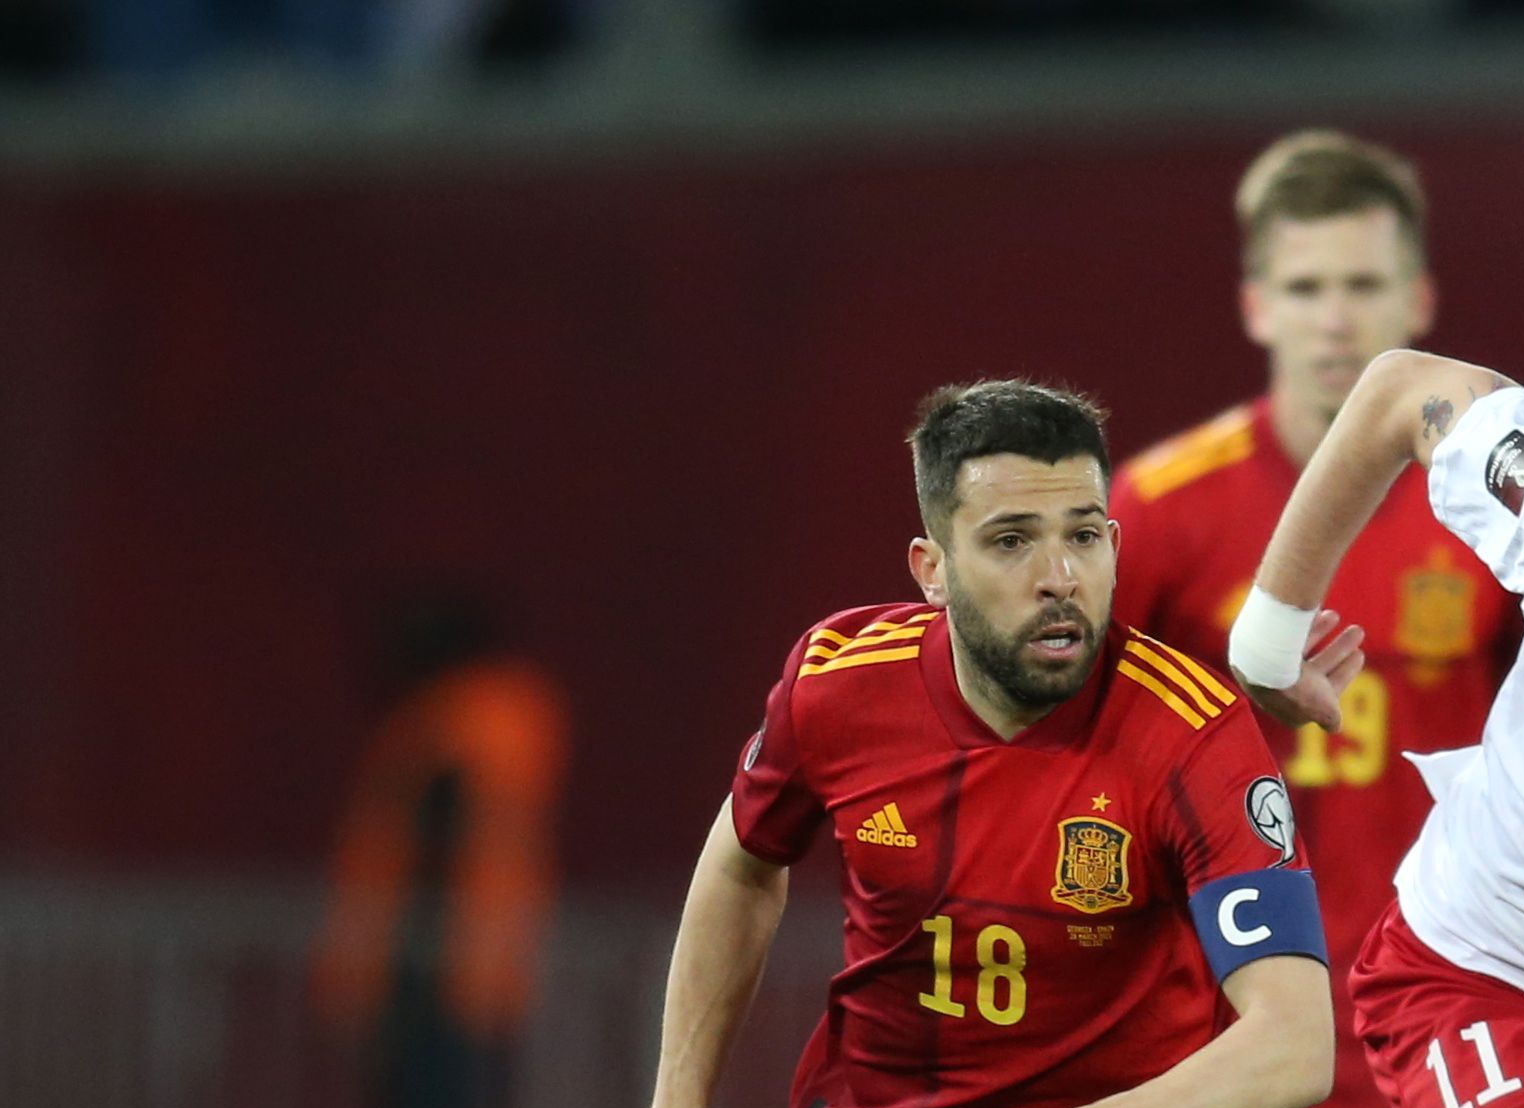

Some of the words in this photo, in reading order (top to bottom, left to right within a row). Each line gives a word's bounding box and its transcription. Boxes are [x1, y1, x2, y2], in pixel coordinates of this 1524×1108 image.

[1284, 668, 1390, 787] 19
[856, 828, 918, 848] adidas
[1218, 888, 1272, 946] C
[918, 916, 1027, 1026] 18
